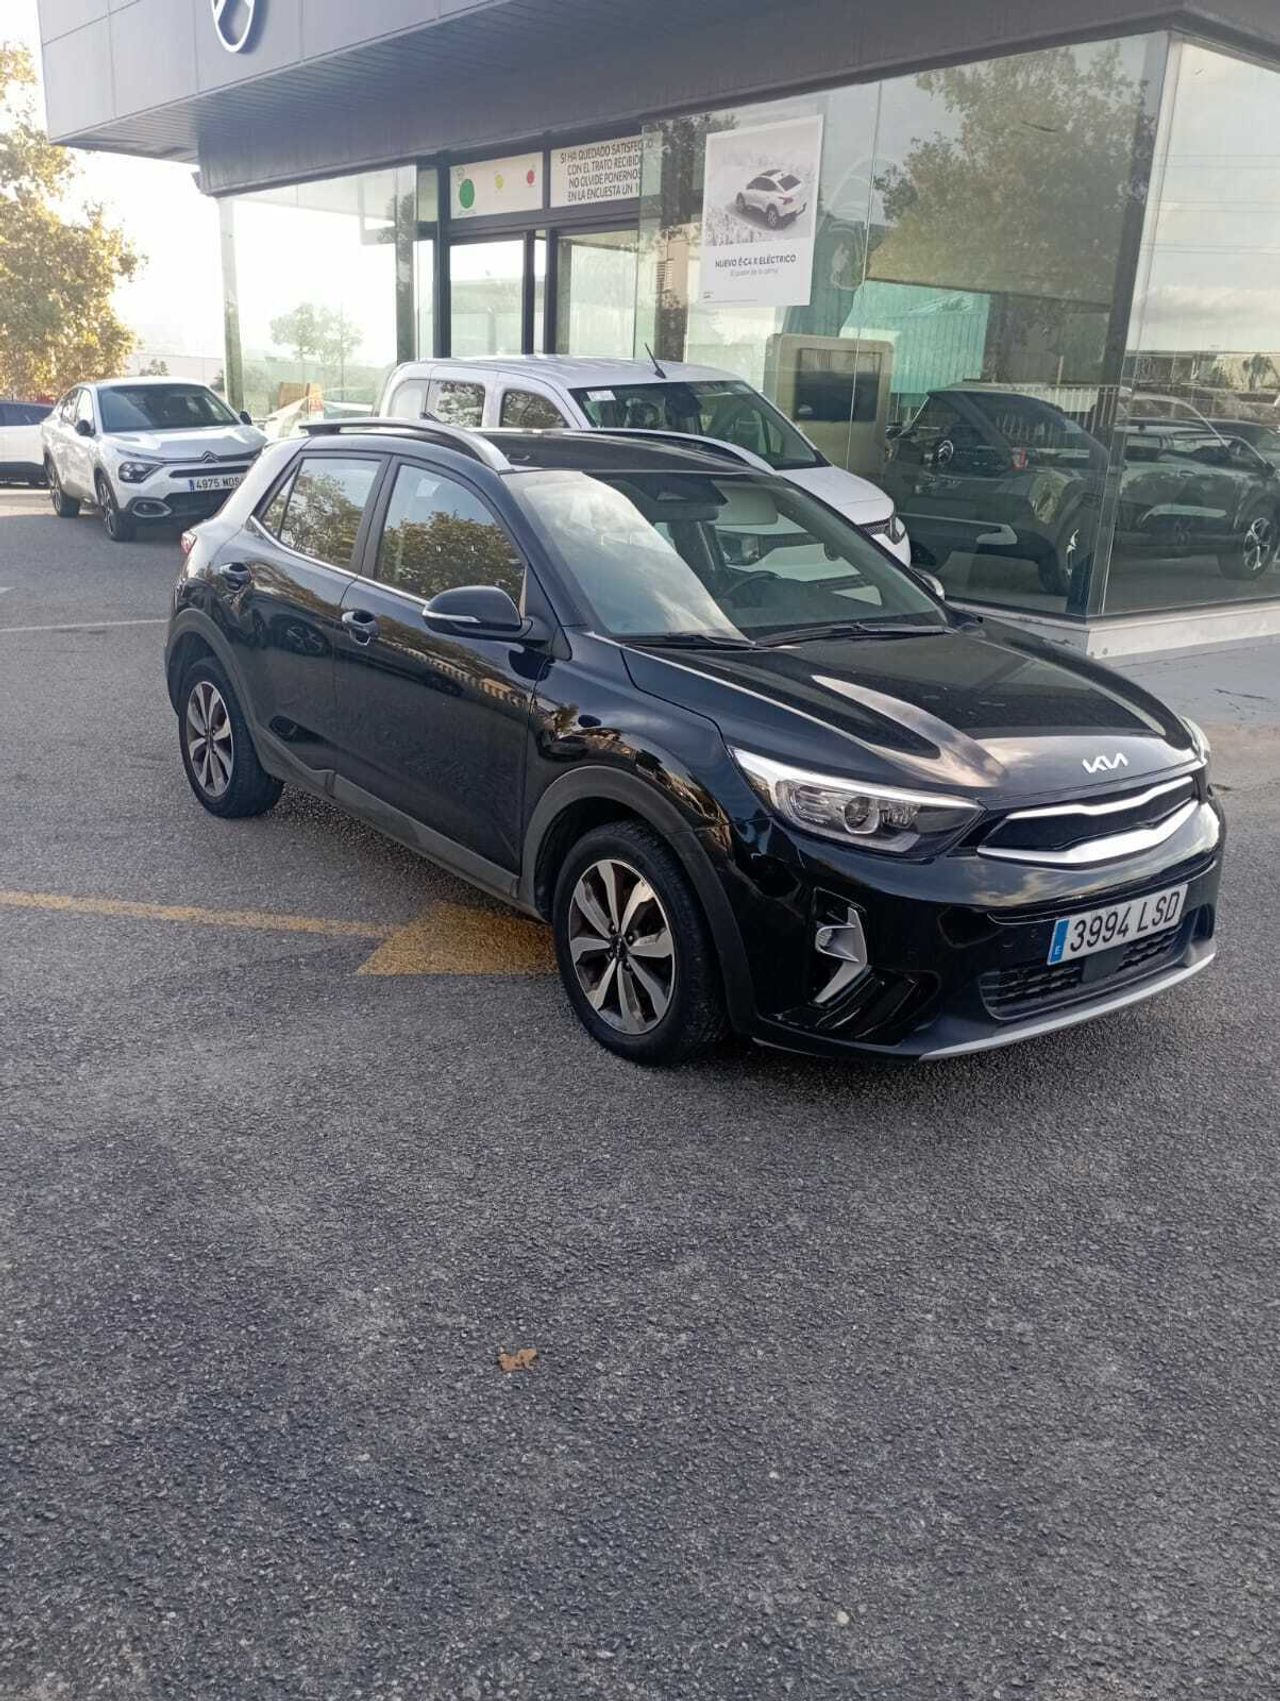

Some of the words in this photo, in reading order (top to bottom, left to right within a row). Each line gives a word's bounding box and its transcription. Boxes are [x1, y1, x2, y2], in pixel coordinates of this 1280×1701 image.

[578, 146, 610, 160] QUEDADO
[611, 138, 653, 156] SATISFECO
[567, 163, 582, 175] CON
[583, 162, 590, 173] EL
[592, 158, 612, 172] TRATO
[614, 154, 639, 169] RECIBID
[569, 176, 579, 188] NO
[580, 173, 604, 187] OLVIDE
[567, 190, 577, 202] EN
[578, 188, 586, 200] LA
[587, 184, 621, 199] ENCUESTA
[622, 183, 632, 195] UN
[715, 259, 737, 268] NUEVO
[759, 253, 797, 265] ELÉCTRICO
[196, 478, 220, 489] 4975
[1082, 752, 1128, 774] KIA
[1070, 906, 1132, 952] 3994
[1137, 891, 1180, 933] LSD
